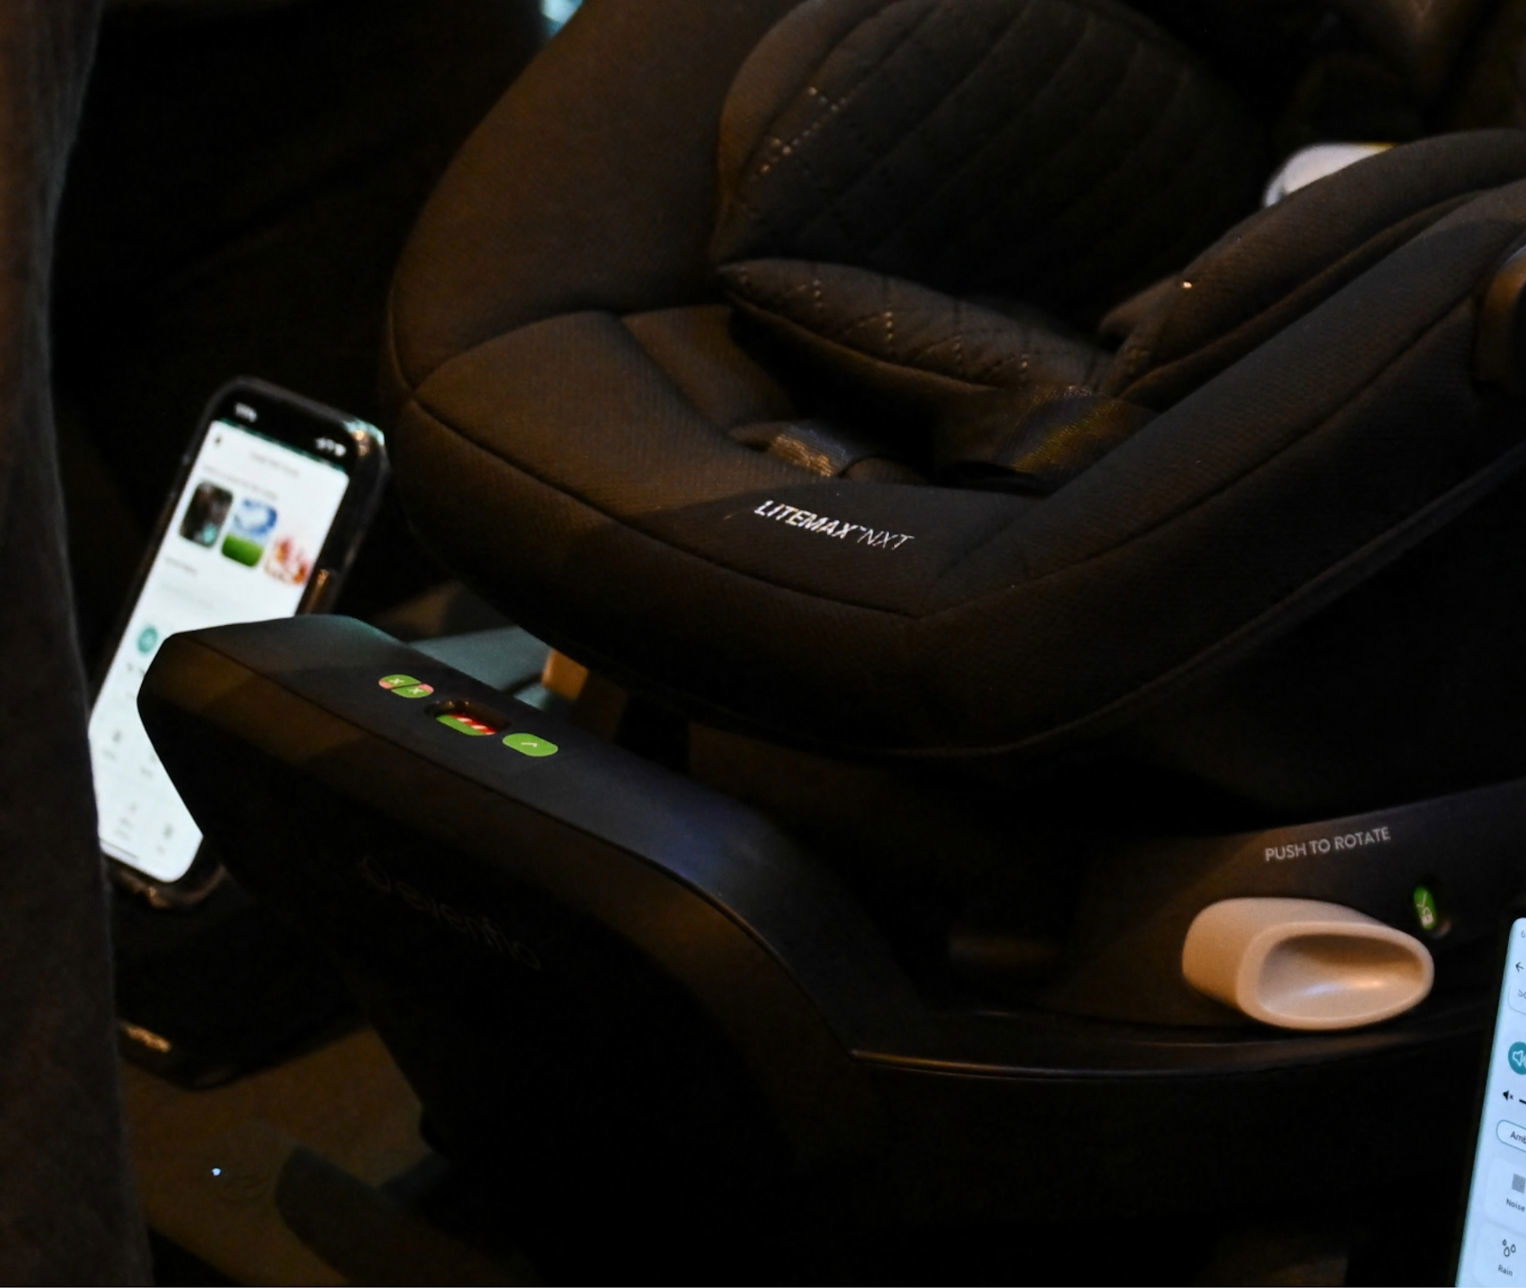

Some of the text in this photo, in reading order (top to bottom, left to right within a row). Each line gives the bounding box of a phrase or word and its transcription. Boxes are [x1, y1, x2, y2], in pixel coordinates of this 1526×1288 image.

[1265, 827, 1391, 862] PUSH TO ROTATE
[1505, 1197, 1526, 1213] Noise
